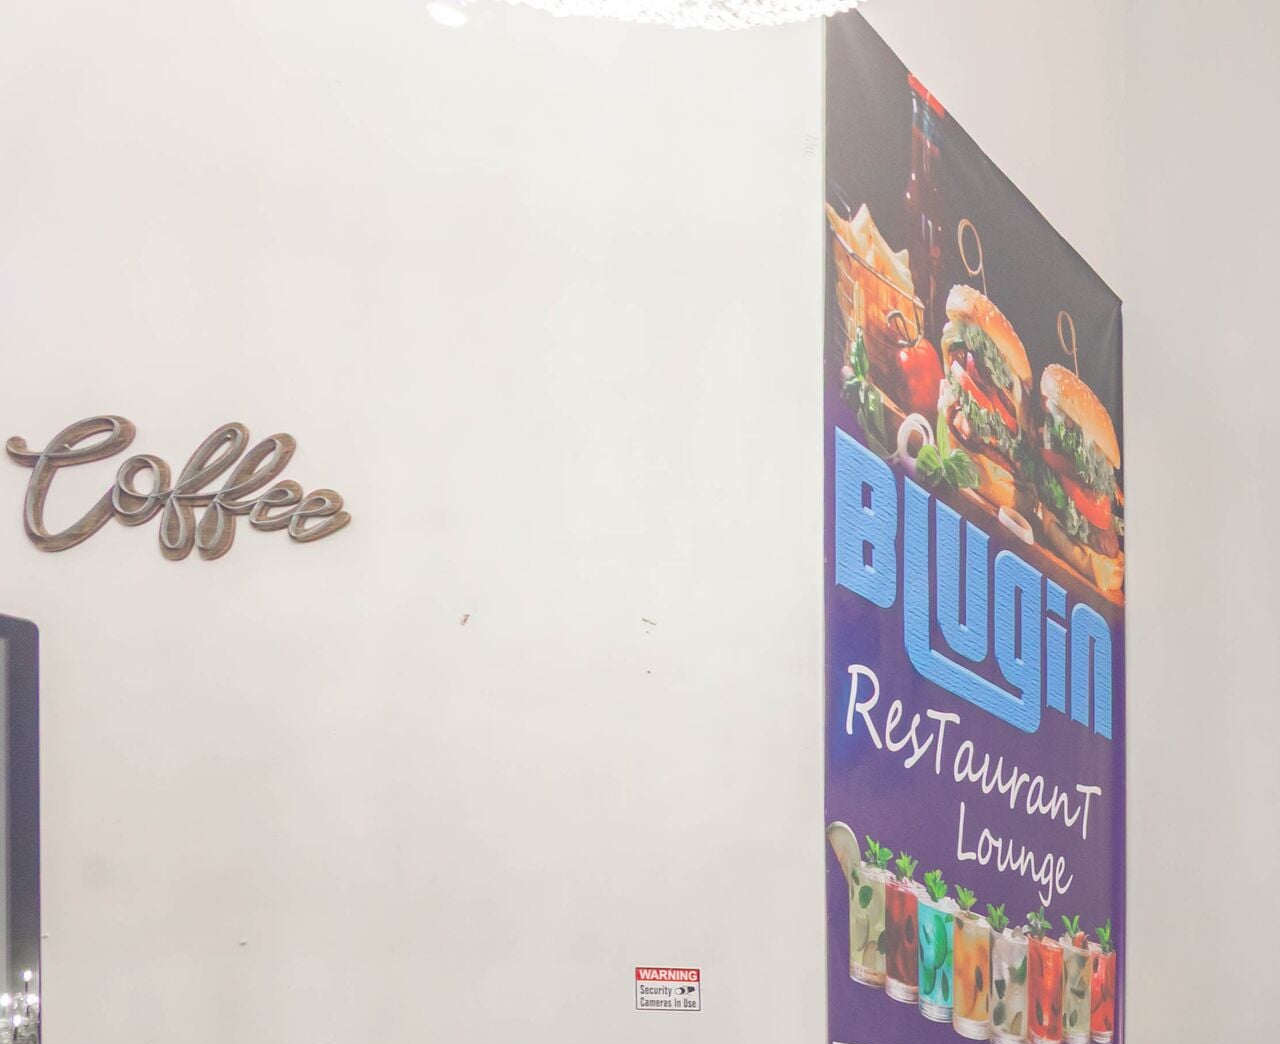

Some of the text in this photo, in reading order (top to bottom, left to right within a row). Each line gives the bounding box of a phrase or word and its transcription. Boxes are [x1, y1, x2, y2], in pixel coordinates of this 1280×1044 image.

[5, 414, 352, 561] Coffee
[957, 801, 1074, 908] Lounge
[639, 969, 698, 981] WARNING
[640, 984, 673, 997] Security
[640, 997, 697, 1009] Cameras In Use
